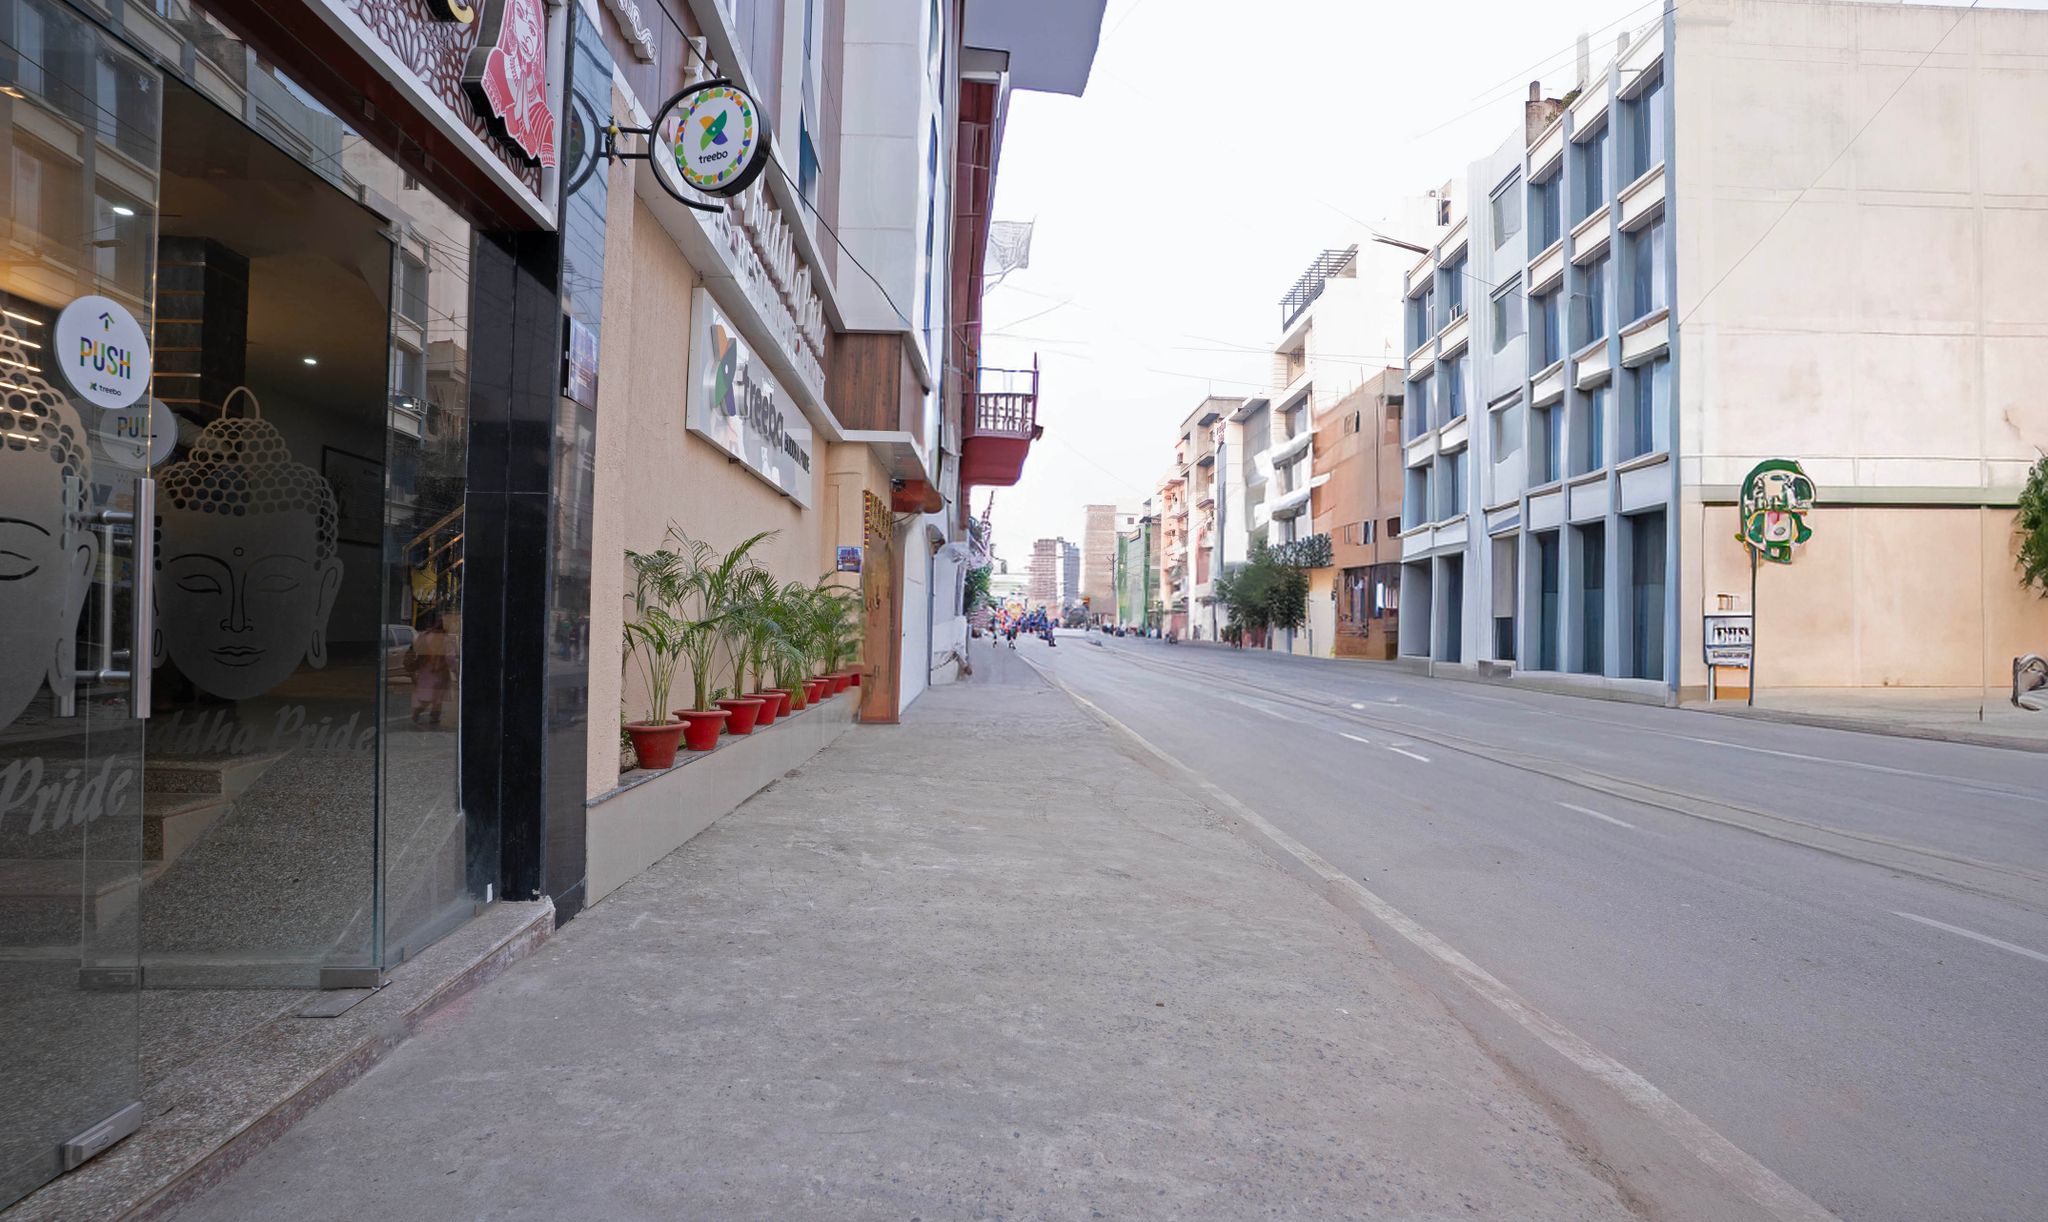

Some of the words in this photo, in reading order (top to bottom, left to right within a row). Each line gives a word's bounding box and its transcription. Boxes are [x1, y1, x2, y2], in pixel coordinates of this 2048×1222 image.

[698, 150, 728, 164] treebo
[80, 336, 131, 379] PUSH
[99, 385, 122, 396] treebo
[117, 416, 158, 438] PUL
[271, 704, 377, 757] Pride
[0, 754, 134, 835] Pride
